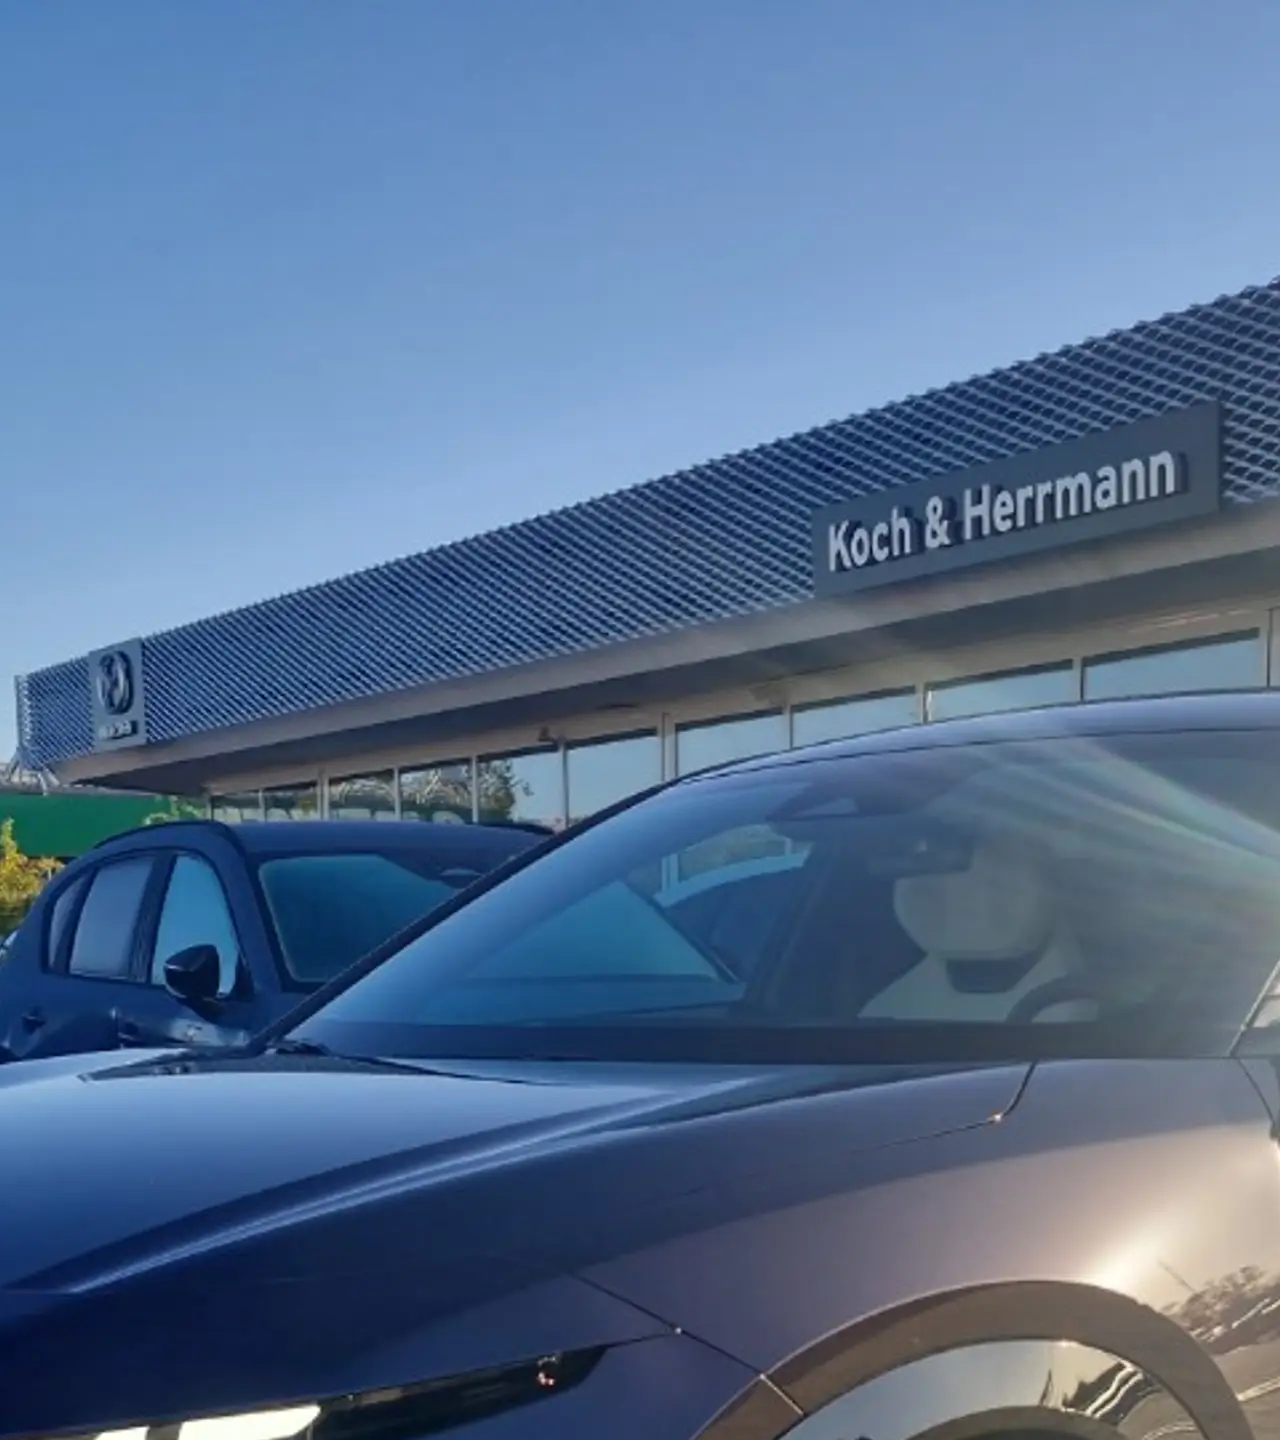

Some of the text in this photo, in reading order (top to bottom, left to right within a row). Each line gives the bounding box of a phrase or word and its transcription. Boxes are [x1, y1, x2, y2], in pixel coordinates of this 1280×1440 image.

[828, 449, 1175, 572] Koch & Herrmann
